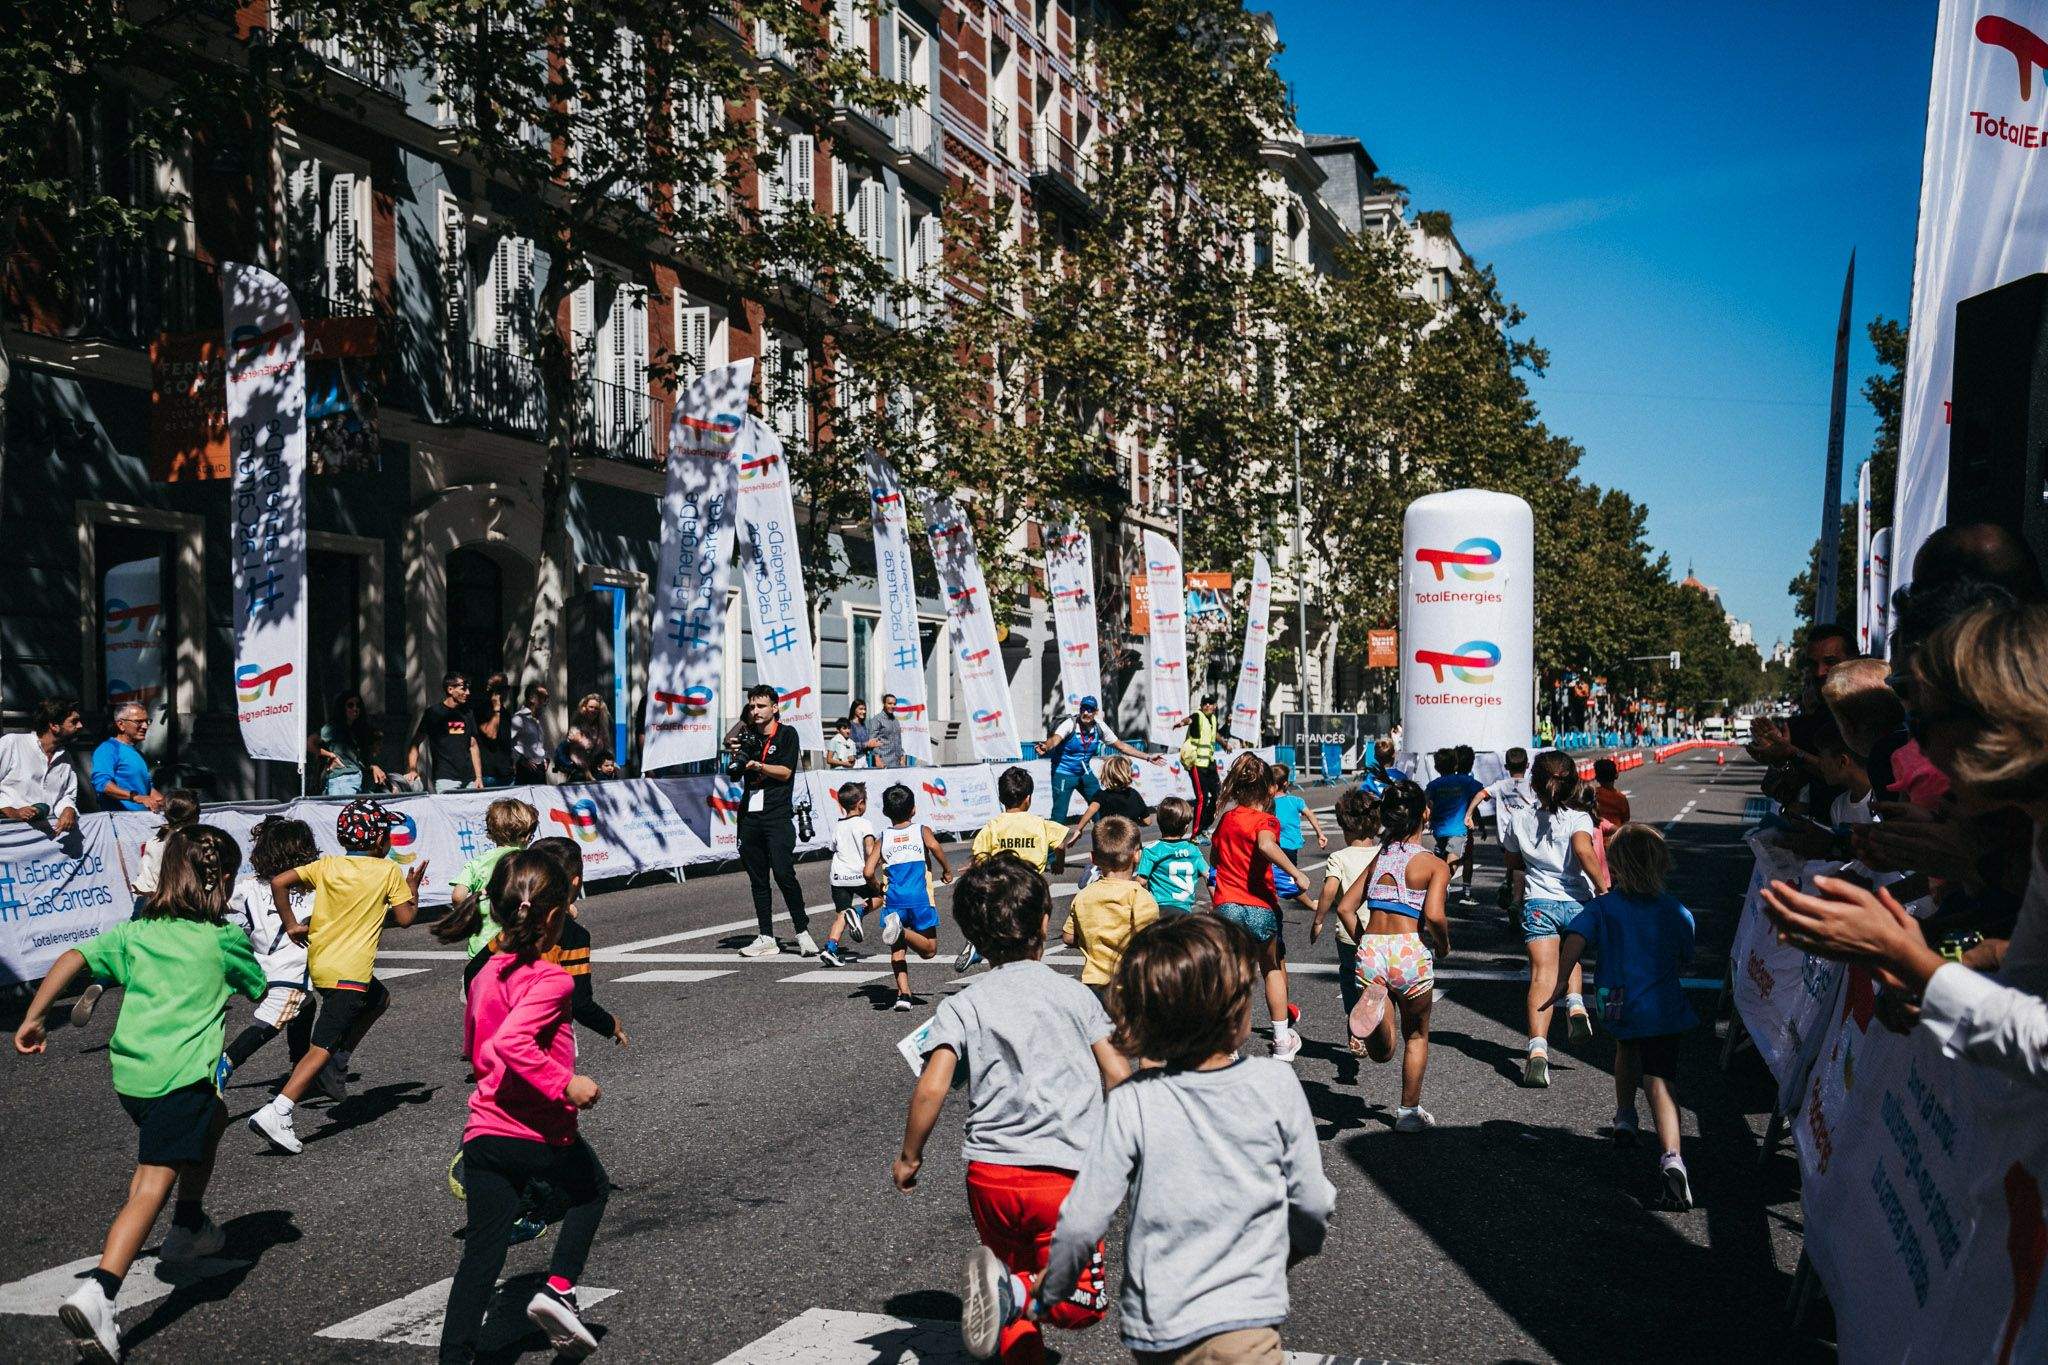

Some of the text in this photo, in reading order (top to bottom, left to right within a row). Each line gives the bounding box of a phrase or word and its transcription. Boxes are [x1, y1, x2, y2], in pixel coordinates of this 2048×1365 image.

[188, 463, 227, 475] ADRID
[694, 493, 724, 612] LasCarreras
[1415, 591, 1503, 605] TotalEnergies
[1415, 693, 1502, 708] TotalEnergies
[651, 722, 712, 733] TotalEnergies
[997, 837, 1036, 849] ABRIEL
[582, 850, 609, 864] nergies
[838, 873, 864, 881] Liberte
[23, 885, 113, 917] LasCarreras
[32, 926, 101, 948] totalenergies.es
